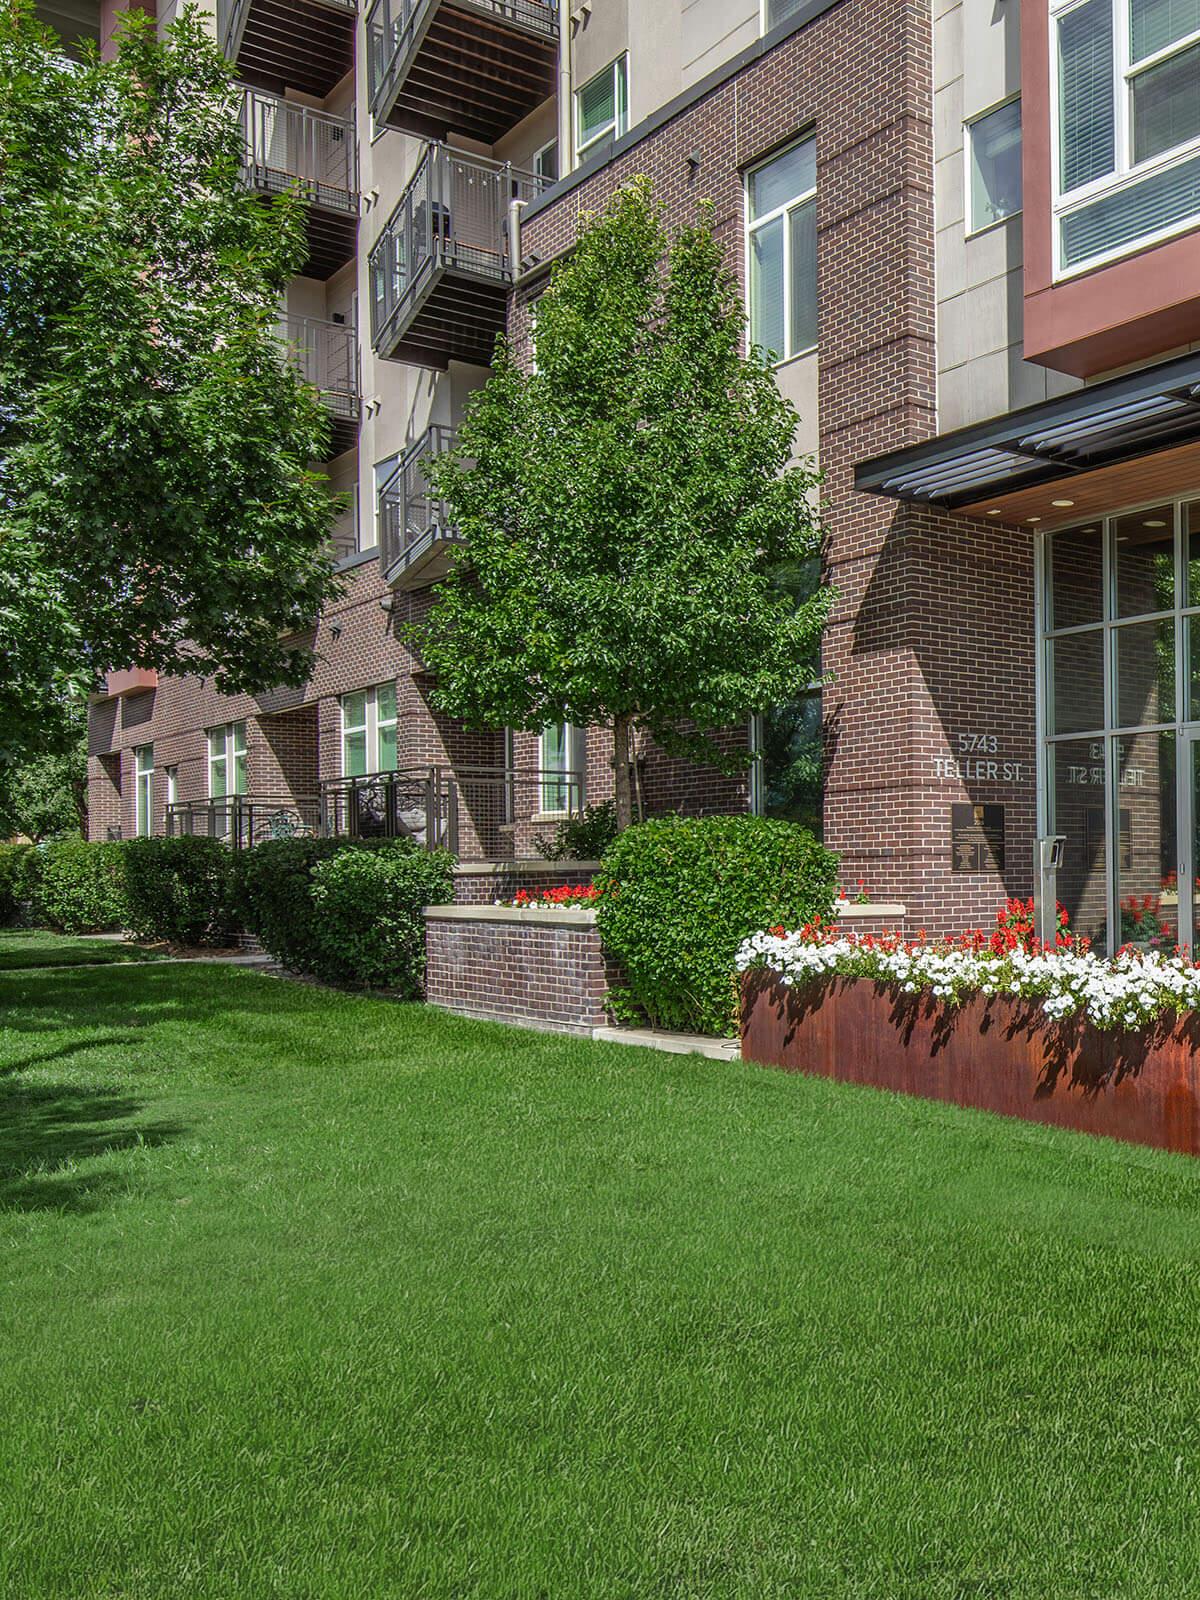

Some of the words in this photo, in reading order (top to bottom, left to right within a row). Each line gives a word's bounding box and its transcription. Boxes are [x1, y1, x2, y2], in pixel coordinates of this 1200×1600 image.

[958, 733, 998, 754] 5743
[933, 758, 998, 780] TELLER
[1003, 762, 1024, 782] ST.
